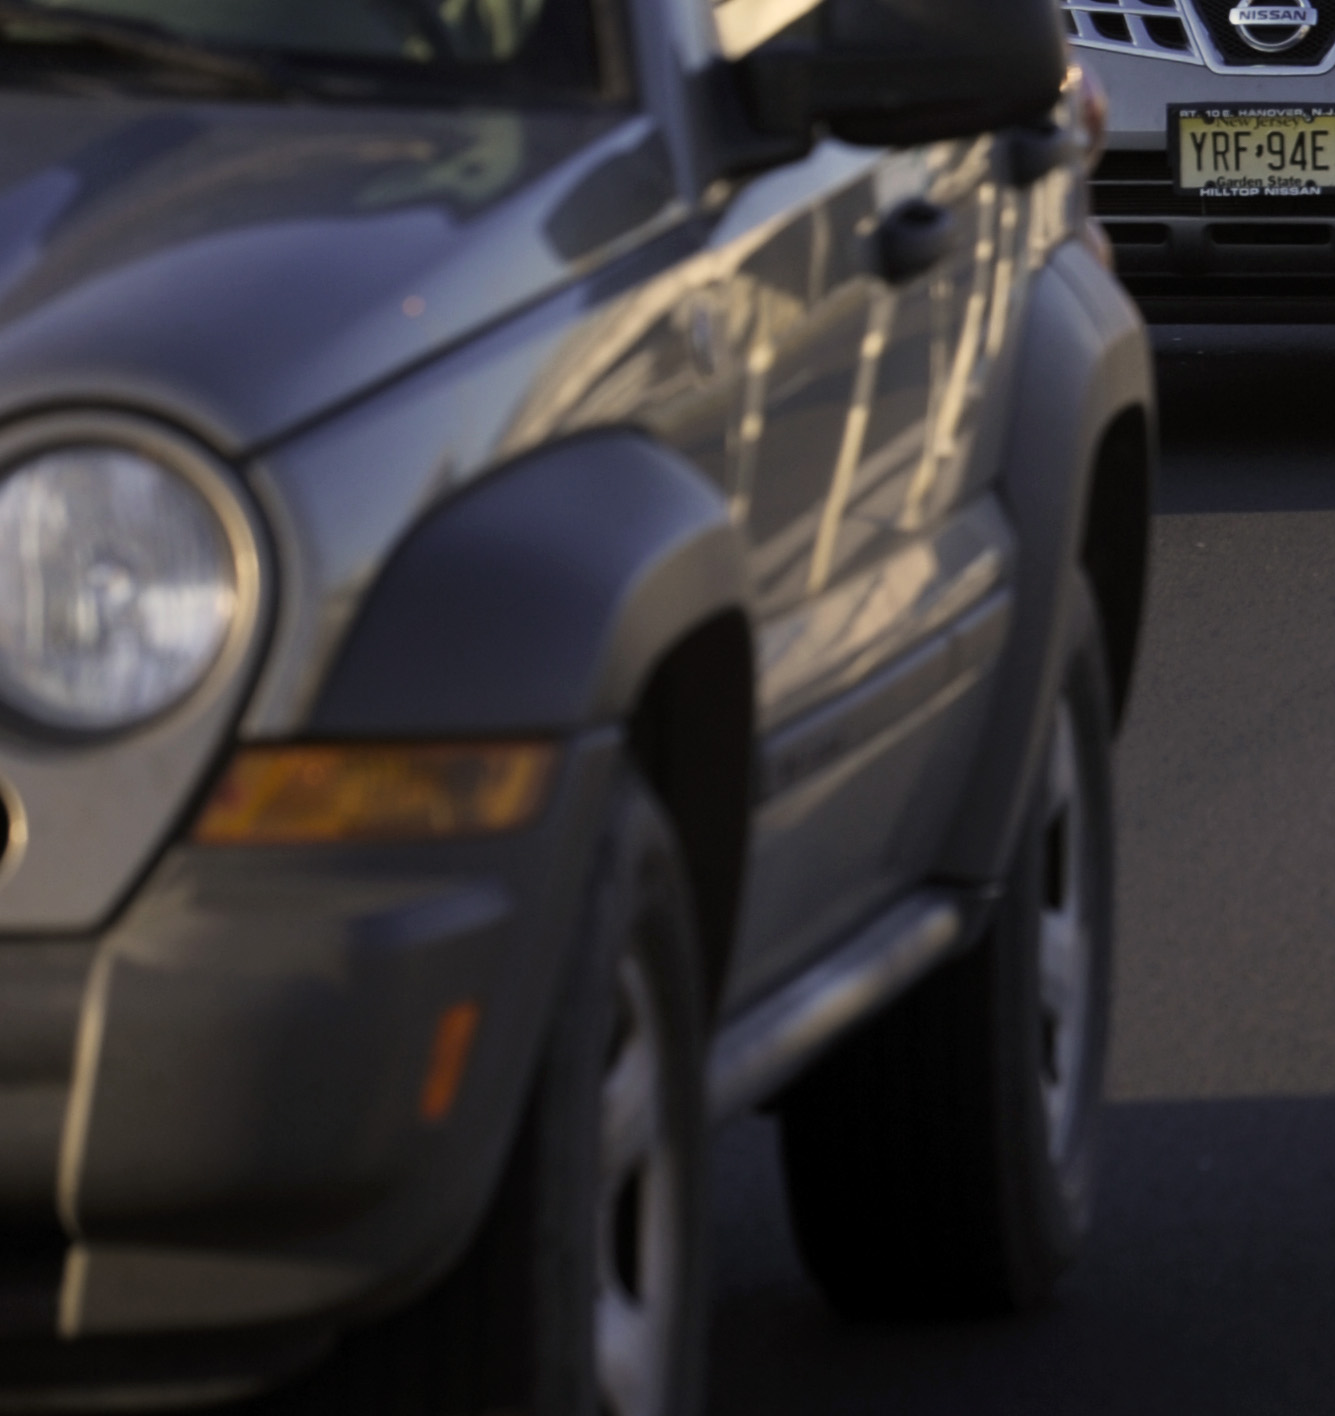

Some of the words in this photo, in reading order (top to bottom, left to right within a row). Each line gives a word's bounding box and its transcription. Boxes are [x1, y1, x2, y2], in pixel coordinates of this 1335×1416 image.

[1239, 10, 1307, 21] NISSAN
[1216, 175, 1263, 188] Garden
[1267, 174, 1303, 187] State
[1200, 187, 1260, 197] HILLTOP
[1264, 186, 1322, 196] NISSAN
